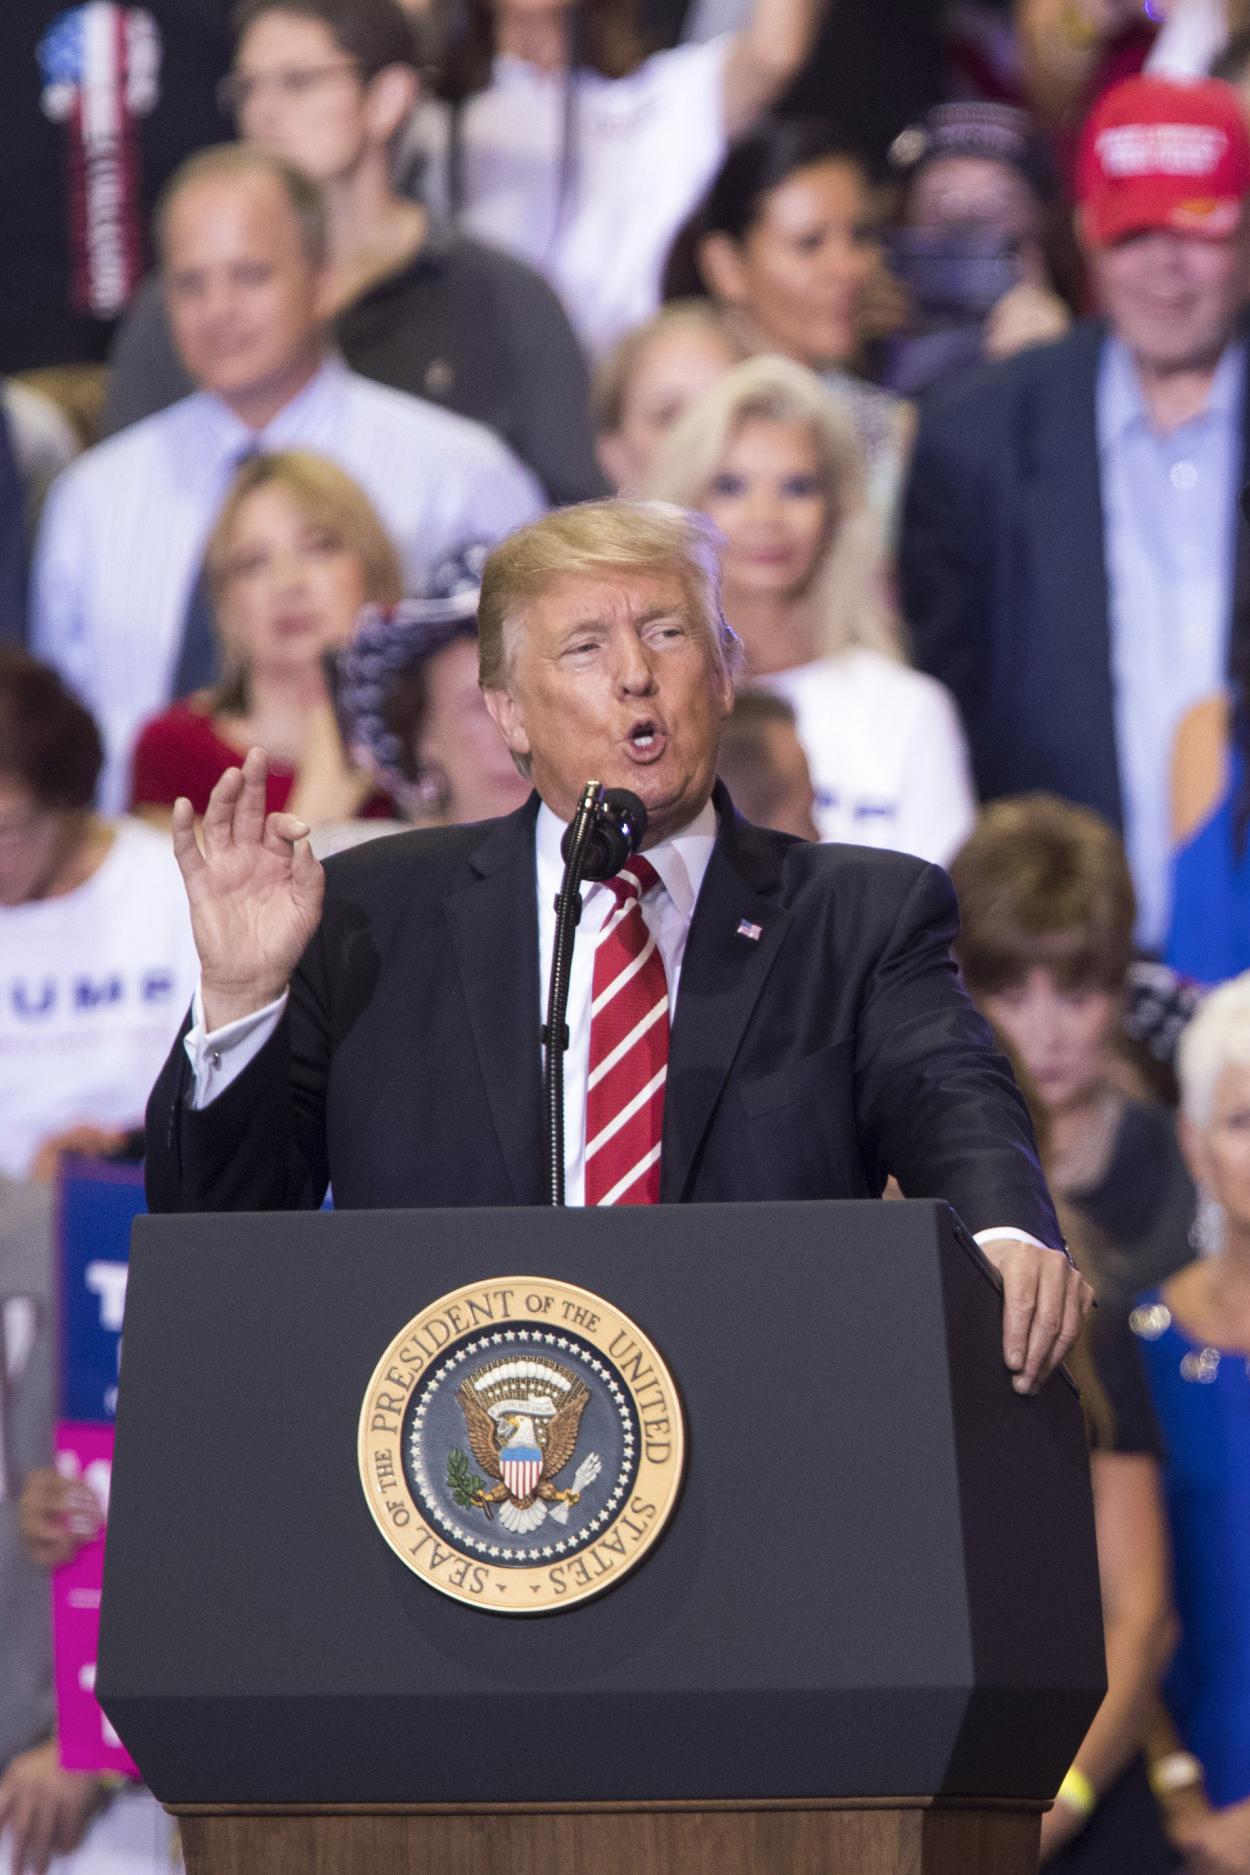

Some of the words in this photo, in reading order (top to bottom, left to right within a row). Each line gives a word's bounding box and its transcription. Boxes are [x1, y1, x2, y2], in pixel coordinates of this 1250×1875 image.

[525, 1294, 555, 1314] OF
[562, 1300, 601, 1332] THE
[371, 1290, 514, 1434] PRESIDENT
[608, 1331, 670, 1465] UNITED
[374, 1449, 396, 1493] THE
[386, 1501, 410, 1527] OF
[409, 1526, 490, 1594] SEAL
[549, 1495, 656, 1595] STATES
